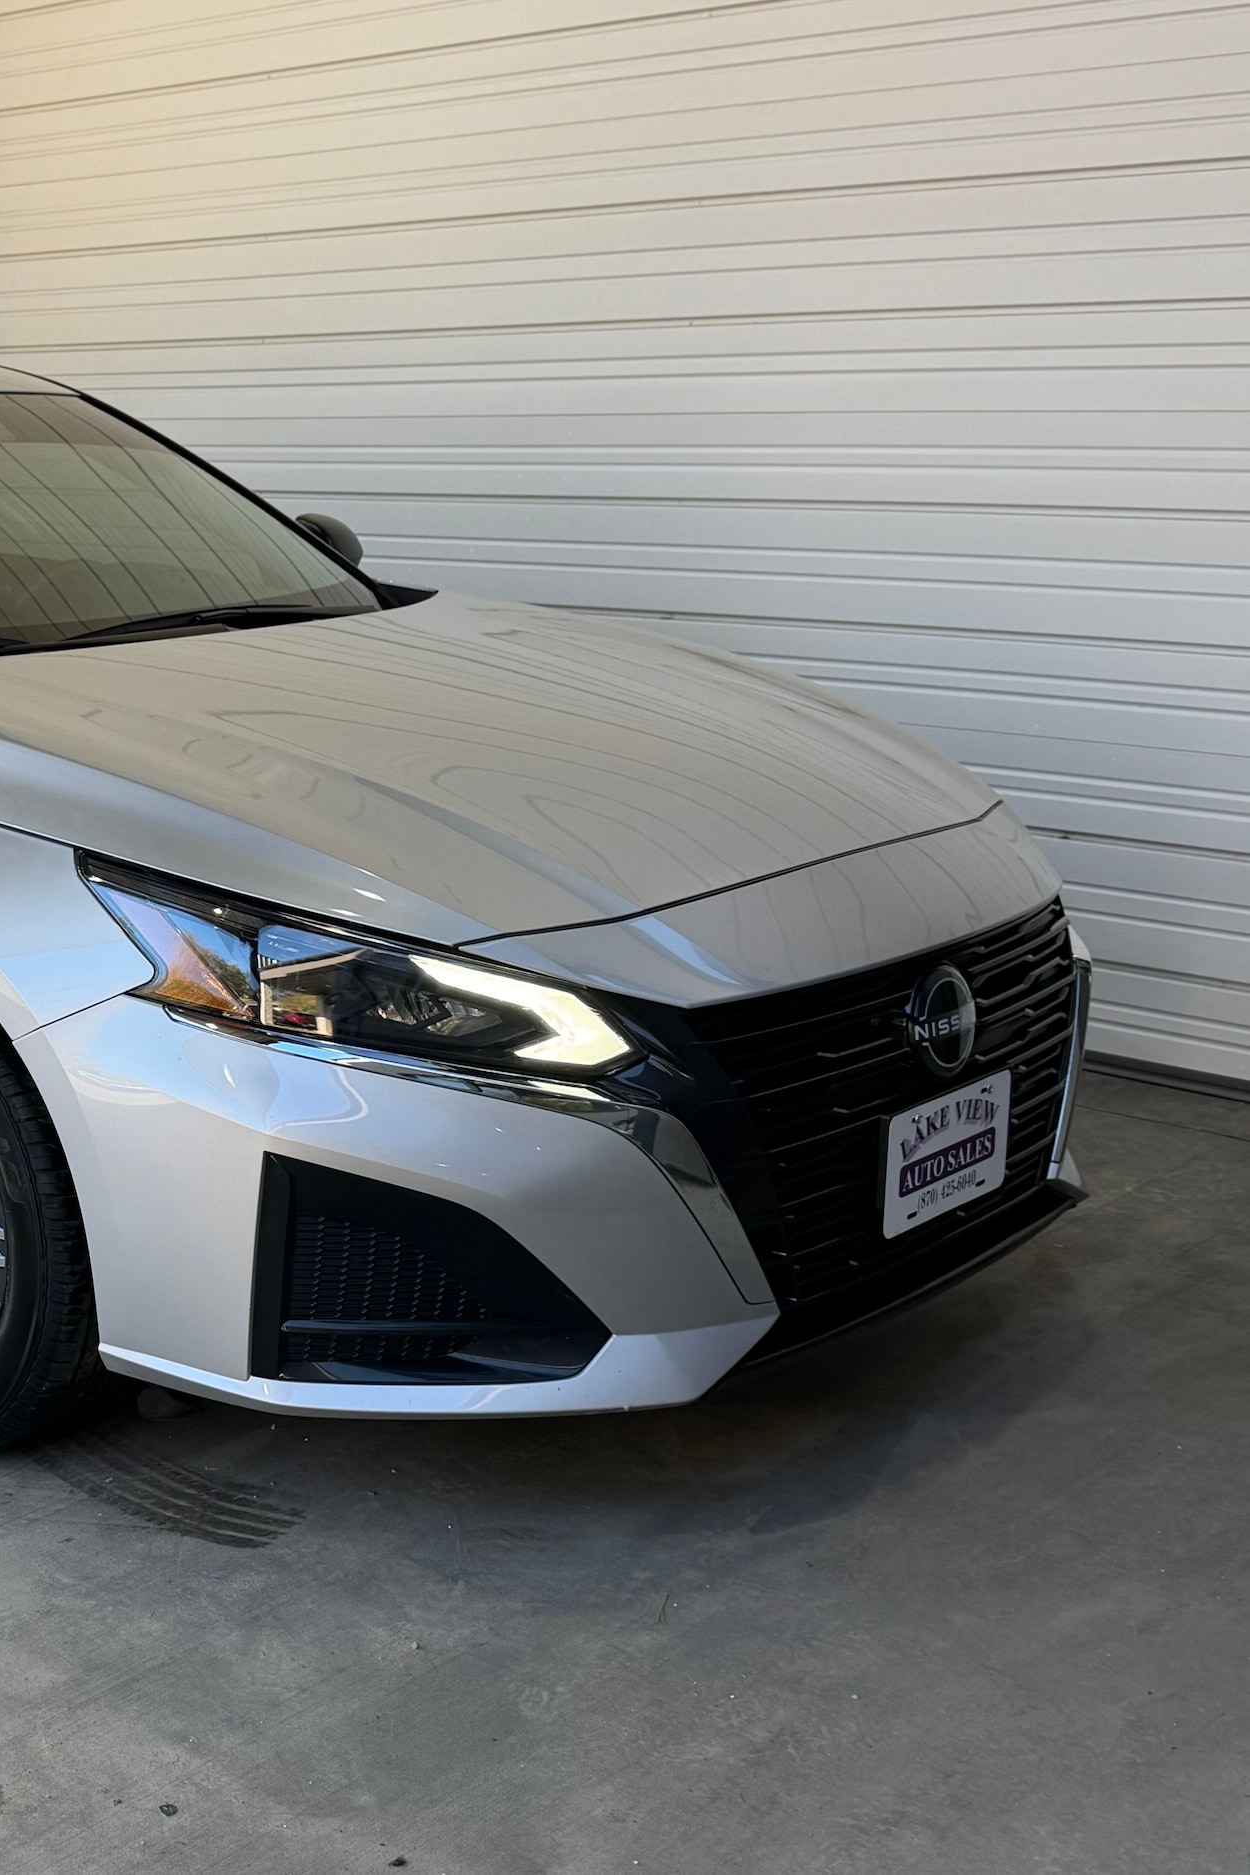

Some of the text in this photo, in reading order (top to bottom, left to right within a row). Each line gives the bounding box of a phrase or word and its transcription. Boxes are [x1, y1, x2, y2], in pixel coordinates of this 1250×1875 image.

[913, 1010, 972, 1041] NISS
[900, 1098, 1000, 1161] LAKE VIEW
[902, 1134, 992, 1192] AUTO SALES
[917, 1187, 939, 1213] (870)
